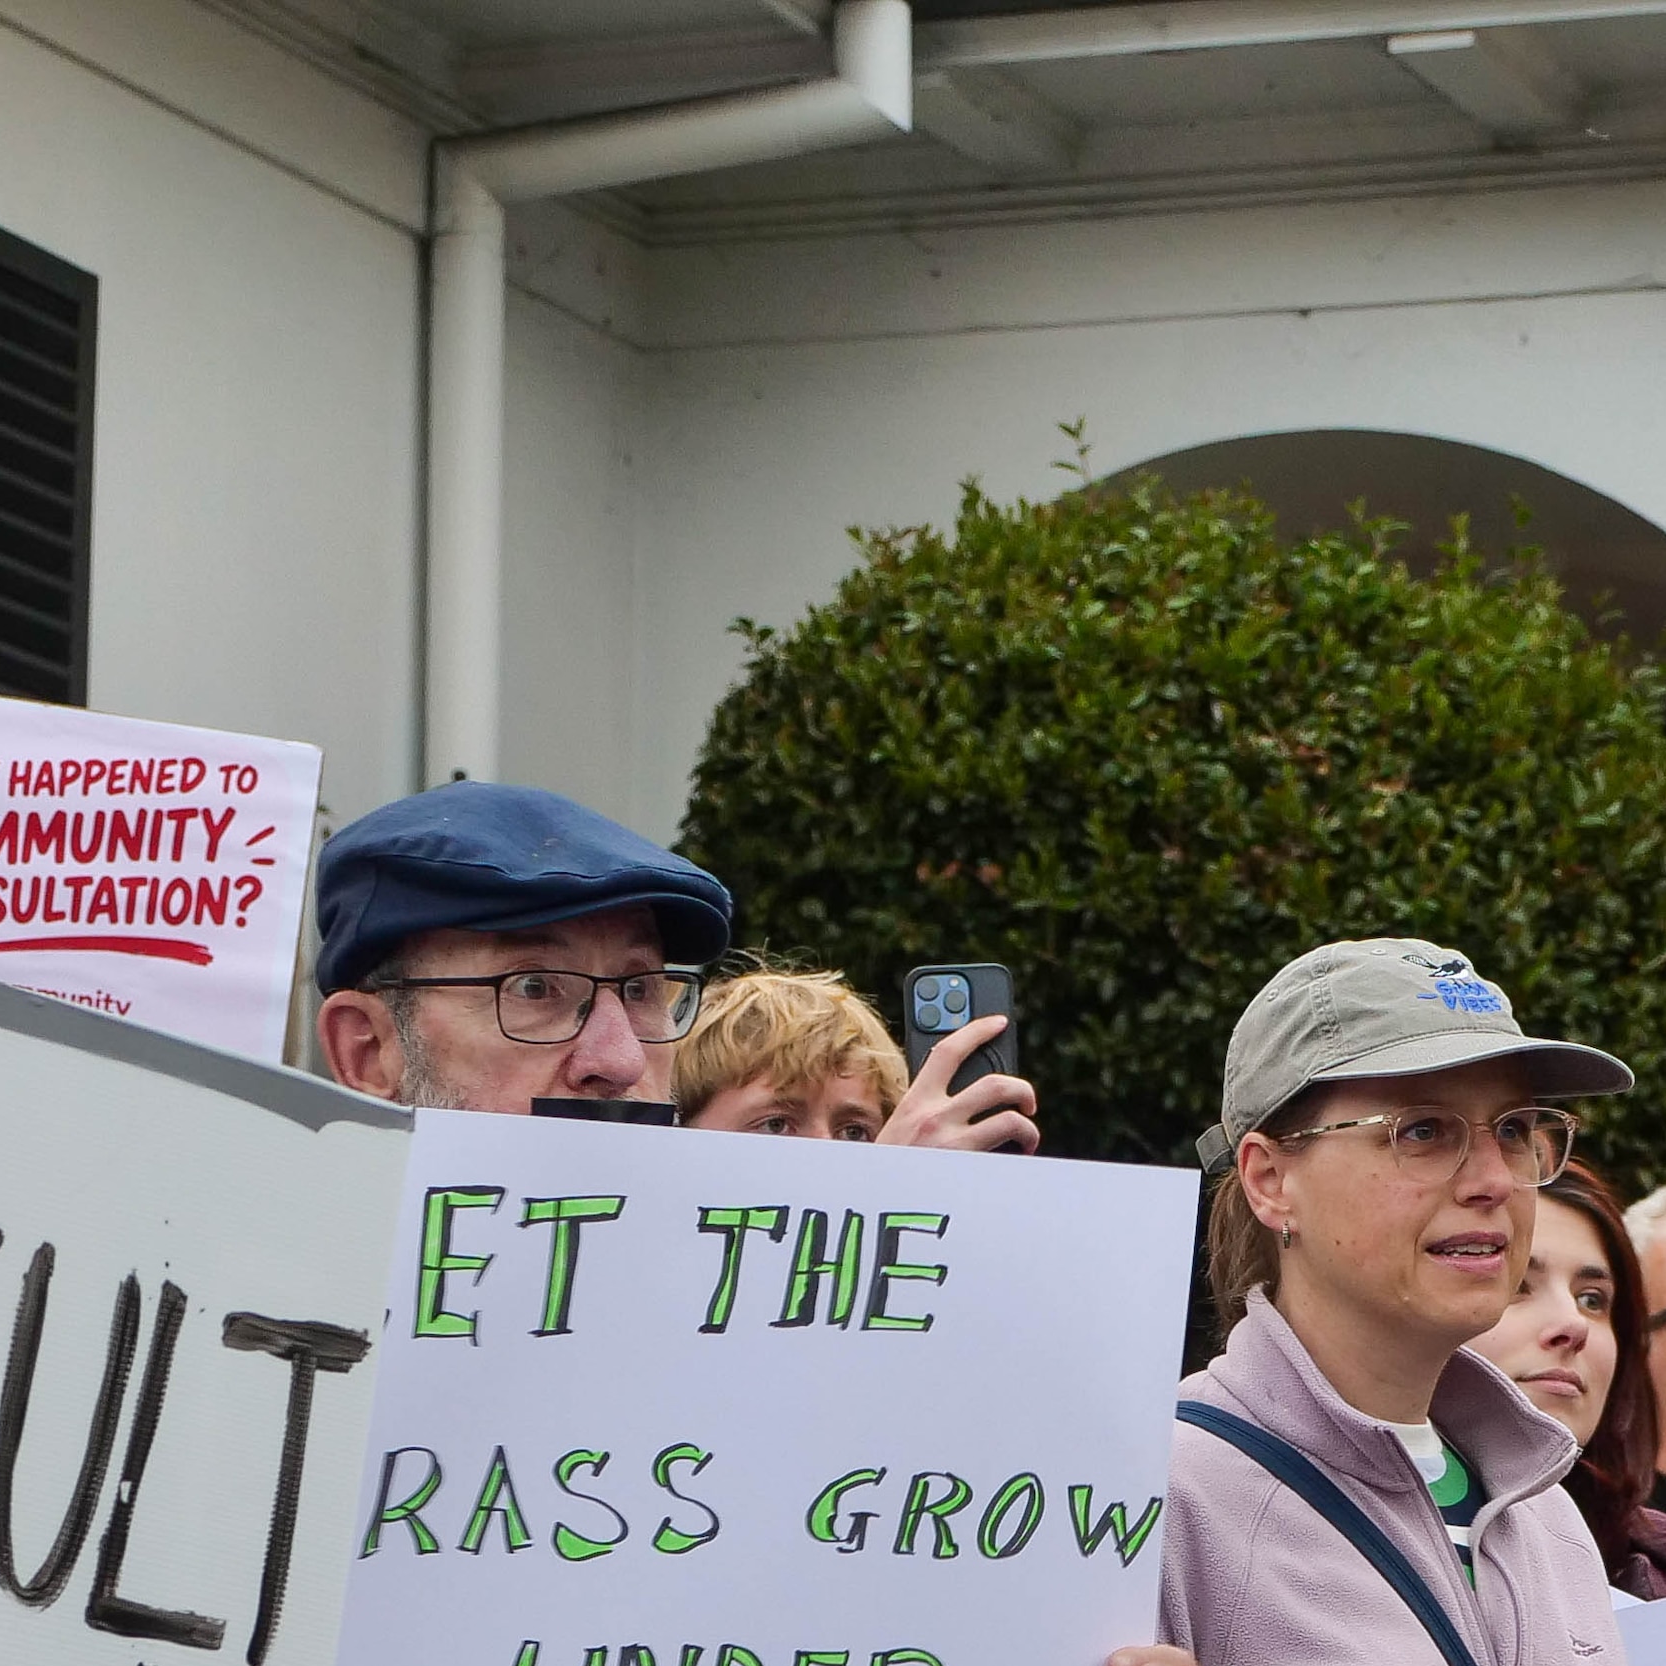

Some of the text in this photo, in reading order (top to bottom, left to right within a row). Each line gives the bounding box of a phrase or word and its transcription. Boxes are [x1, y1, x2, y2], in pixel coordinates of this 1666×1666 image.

[9, 757, 206, 797] HAPPENED
[219, 764, 259, 794] TO
[411, 1184, 949, 1346] ET THE
[357, 1442, 1167, 1569] RASS GROW
